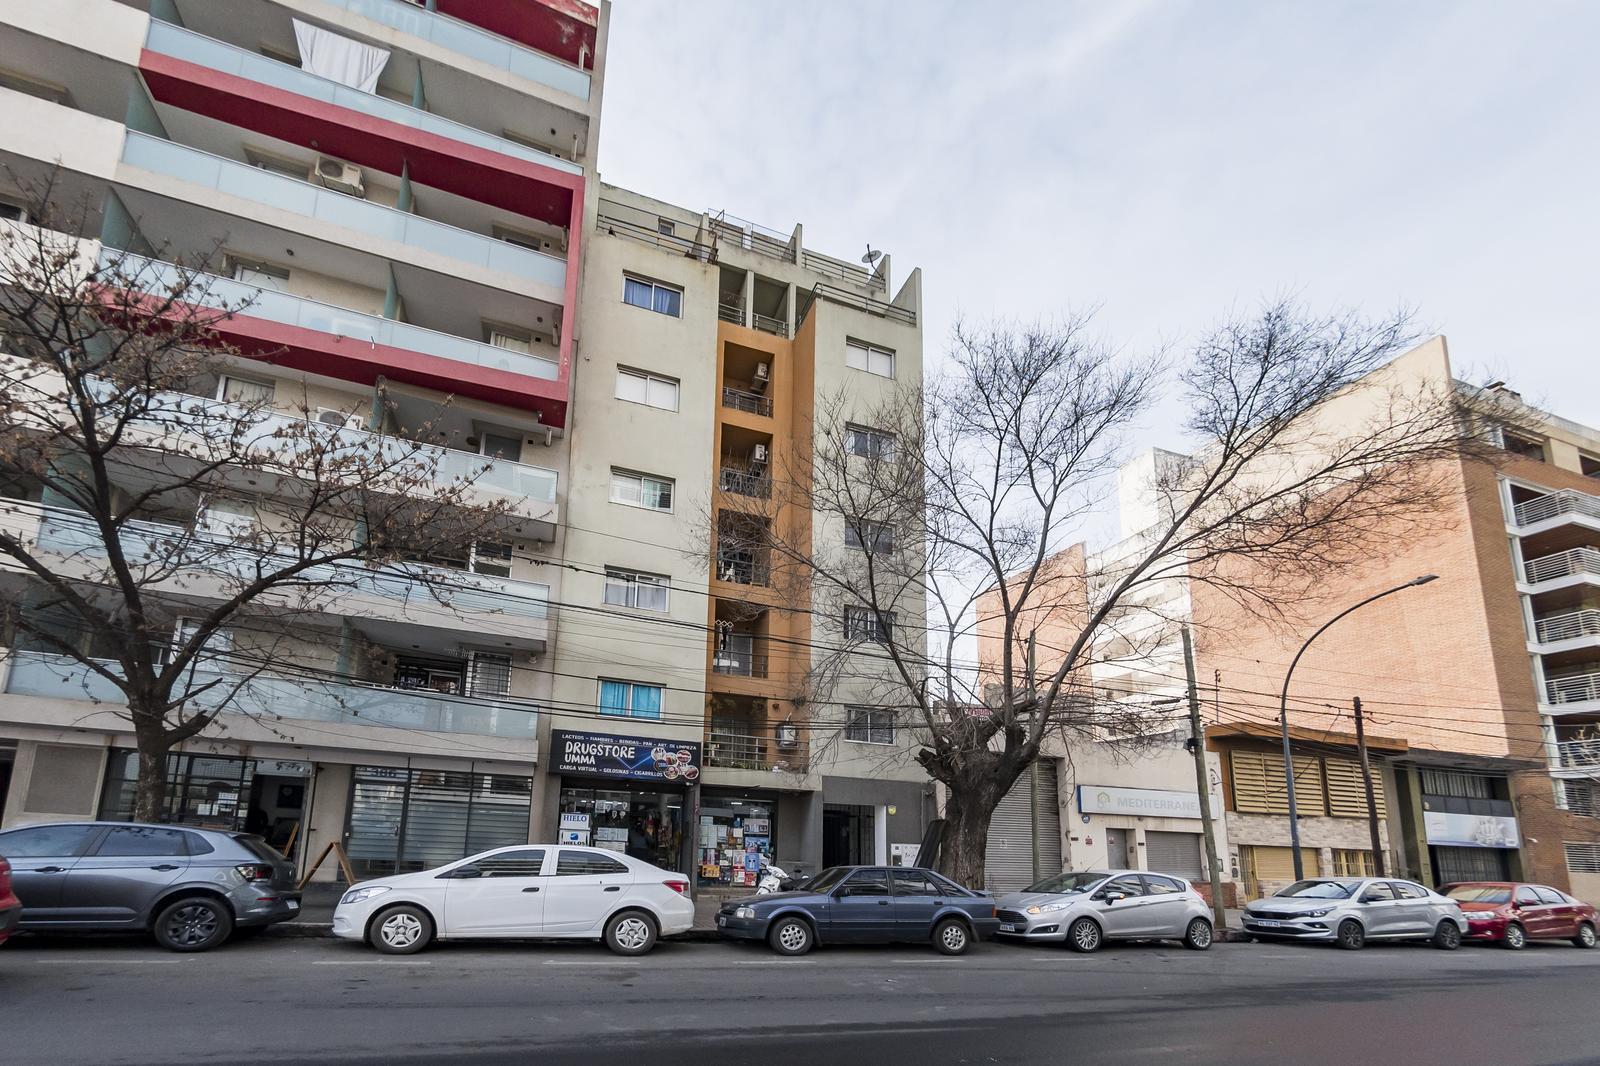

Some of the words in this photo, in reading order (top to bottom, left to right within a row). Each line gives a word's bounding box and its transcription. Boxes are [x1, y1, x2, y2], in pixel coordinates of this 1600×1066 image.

[565, 741, 635, 759] DRUGSTORE
[564, 754, 596, 764] UMMA
[1117, 797, 1200, 811] MEDITERRANE
